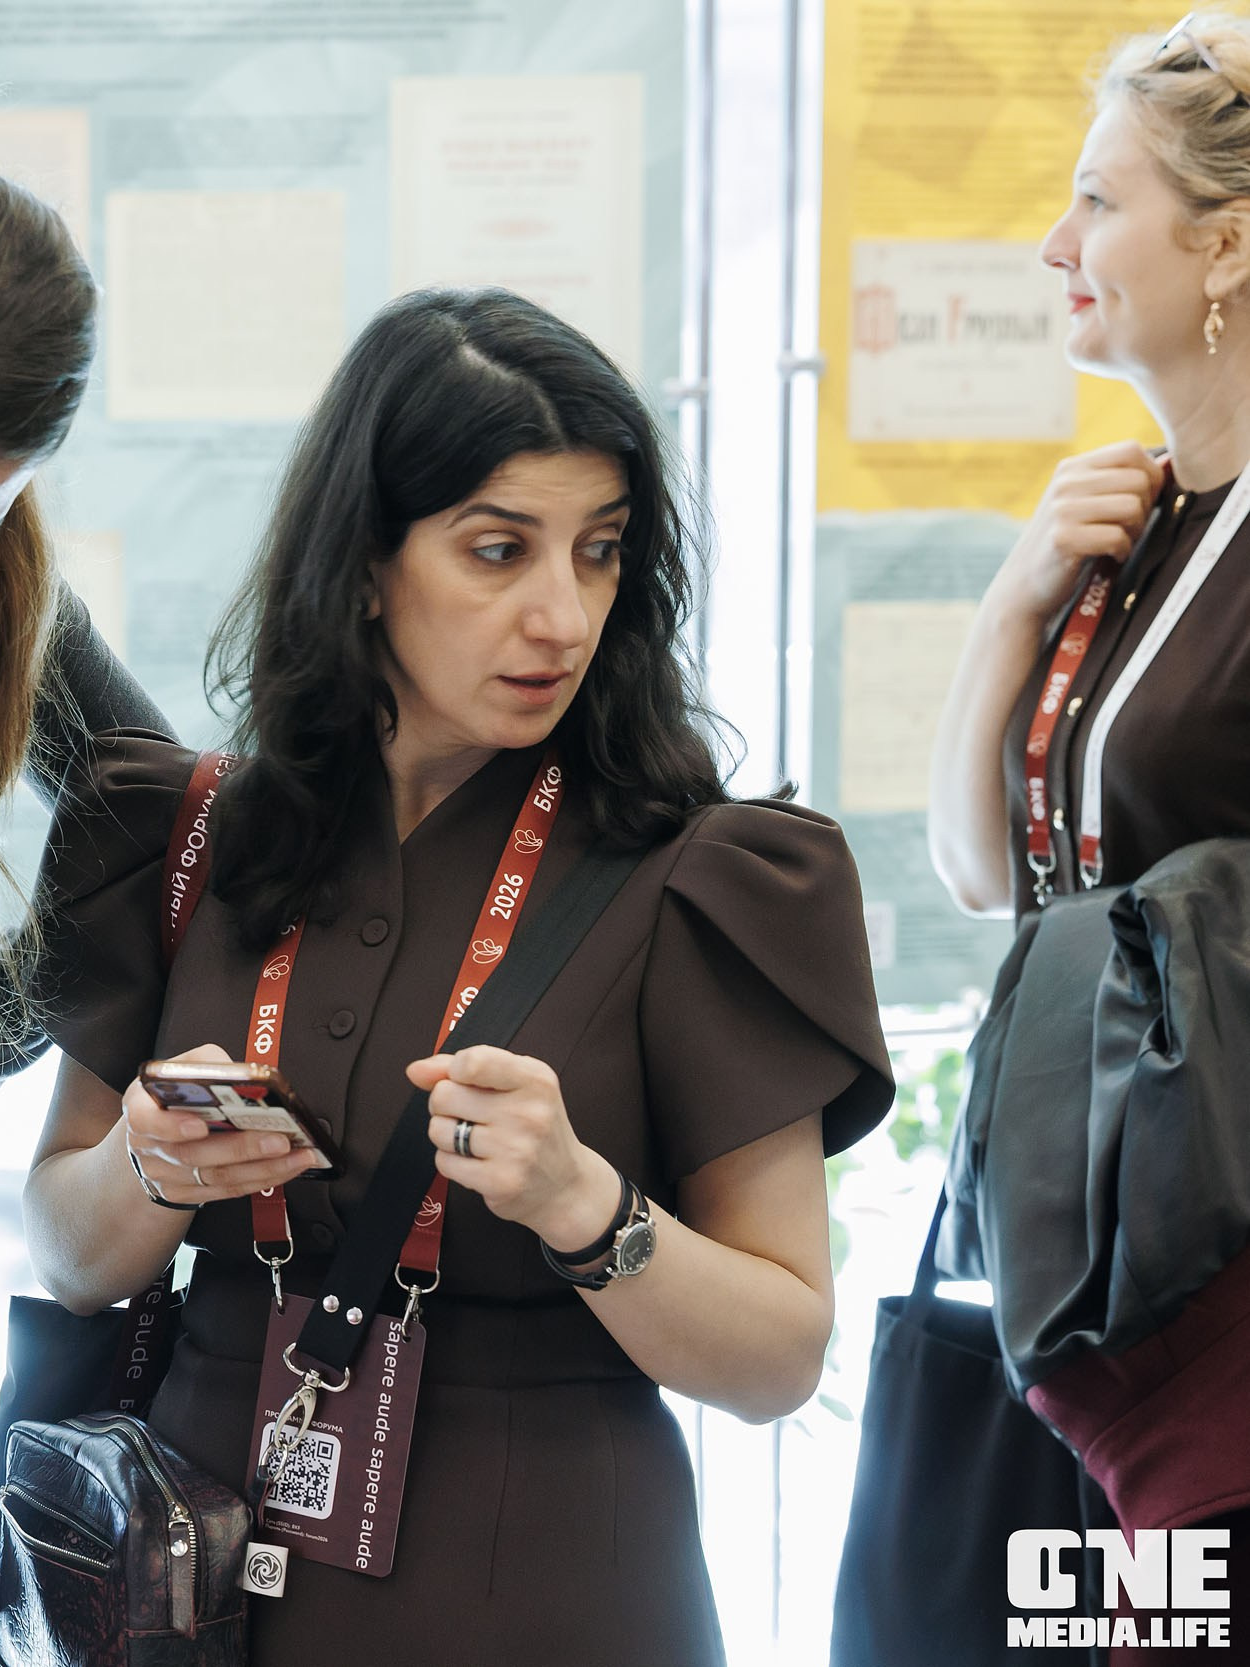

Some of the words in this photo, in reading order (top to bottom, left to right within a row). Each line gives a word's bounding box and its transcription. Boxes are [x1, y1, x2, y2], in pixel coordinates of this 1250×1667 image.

[533, 765, 562, 813] БКФ
[490, 873, 524, 920] 2026
[254, 1004, 278, 1055] БКФ
[126, 1313, 155, 1379] aude
[381, 1321, 401, 1387] sapere
[311, 1420, 344, 1434] ФОРУМА
[374, 1392, 392, 1442] aude
[363, 1448, 384, 1514] sapere
[356, 1519, 374, 1569] aude
